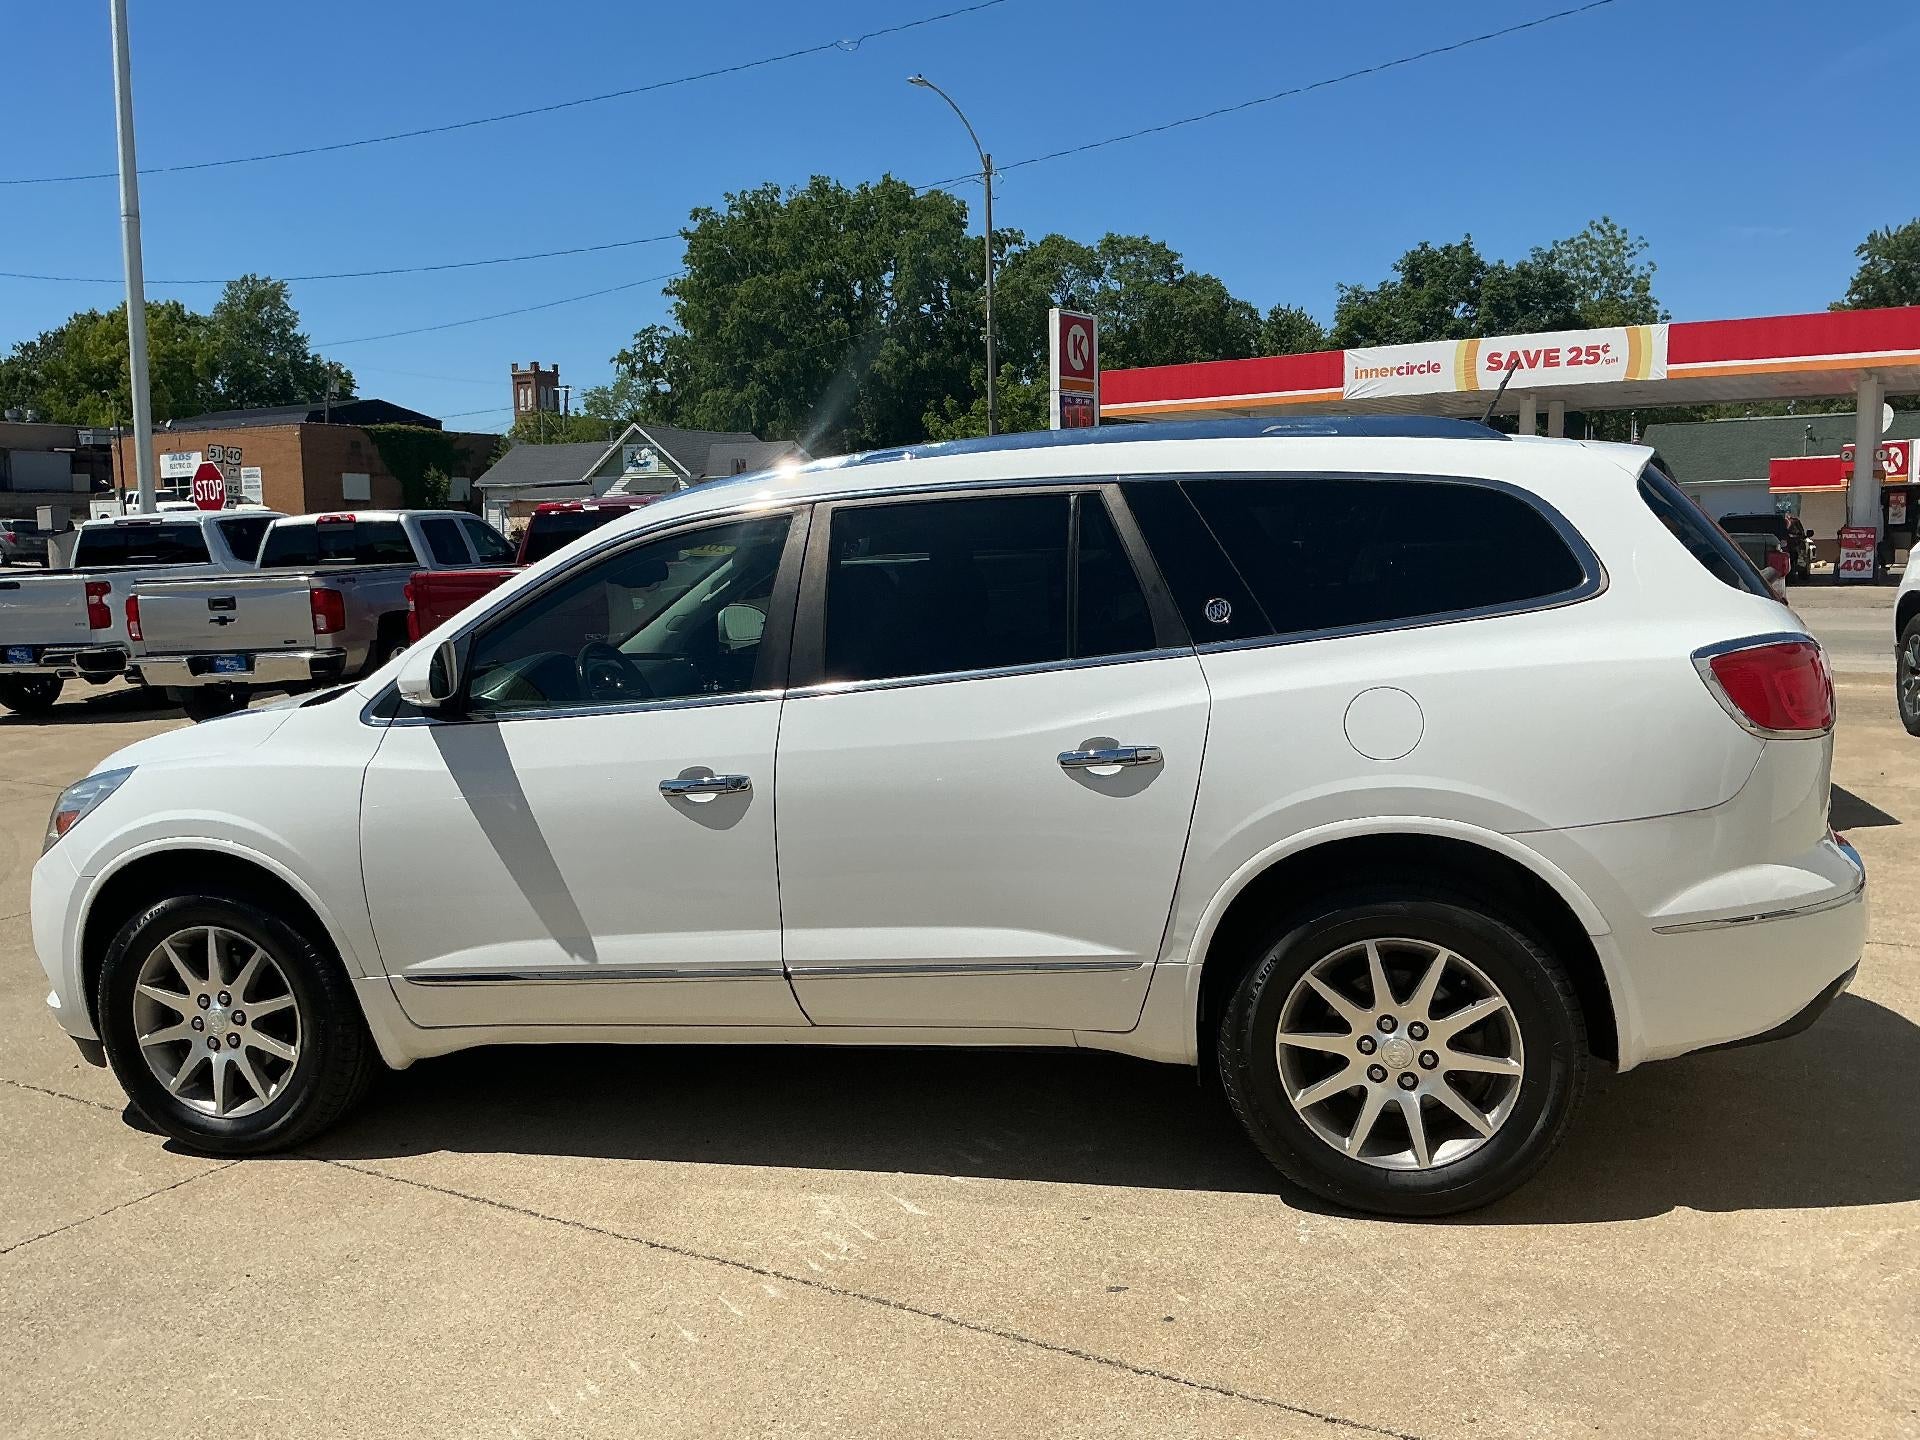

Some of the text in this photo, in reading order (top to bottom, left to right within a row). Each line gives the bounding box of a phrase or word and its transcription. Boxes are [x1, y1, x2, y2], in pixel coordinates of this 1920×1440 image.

[1486, 348, 1561, 371] SAVE
[1354, 360, 1441, 380] innercircle
[209, 448, 241, 461] 51 40
[195, 480, 223, 501] STOP
